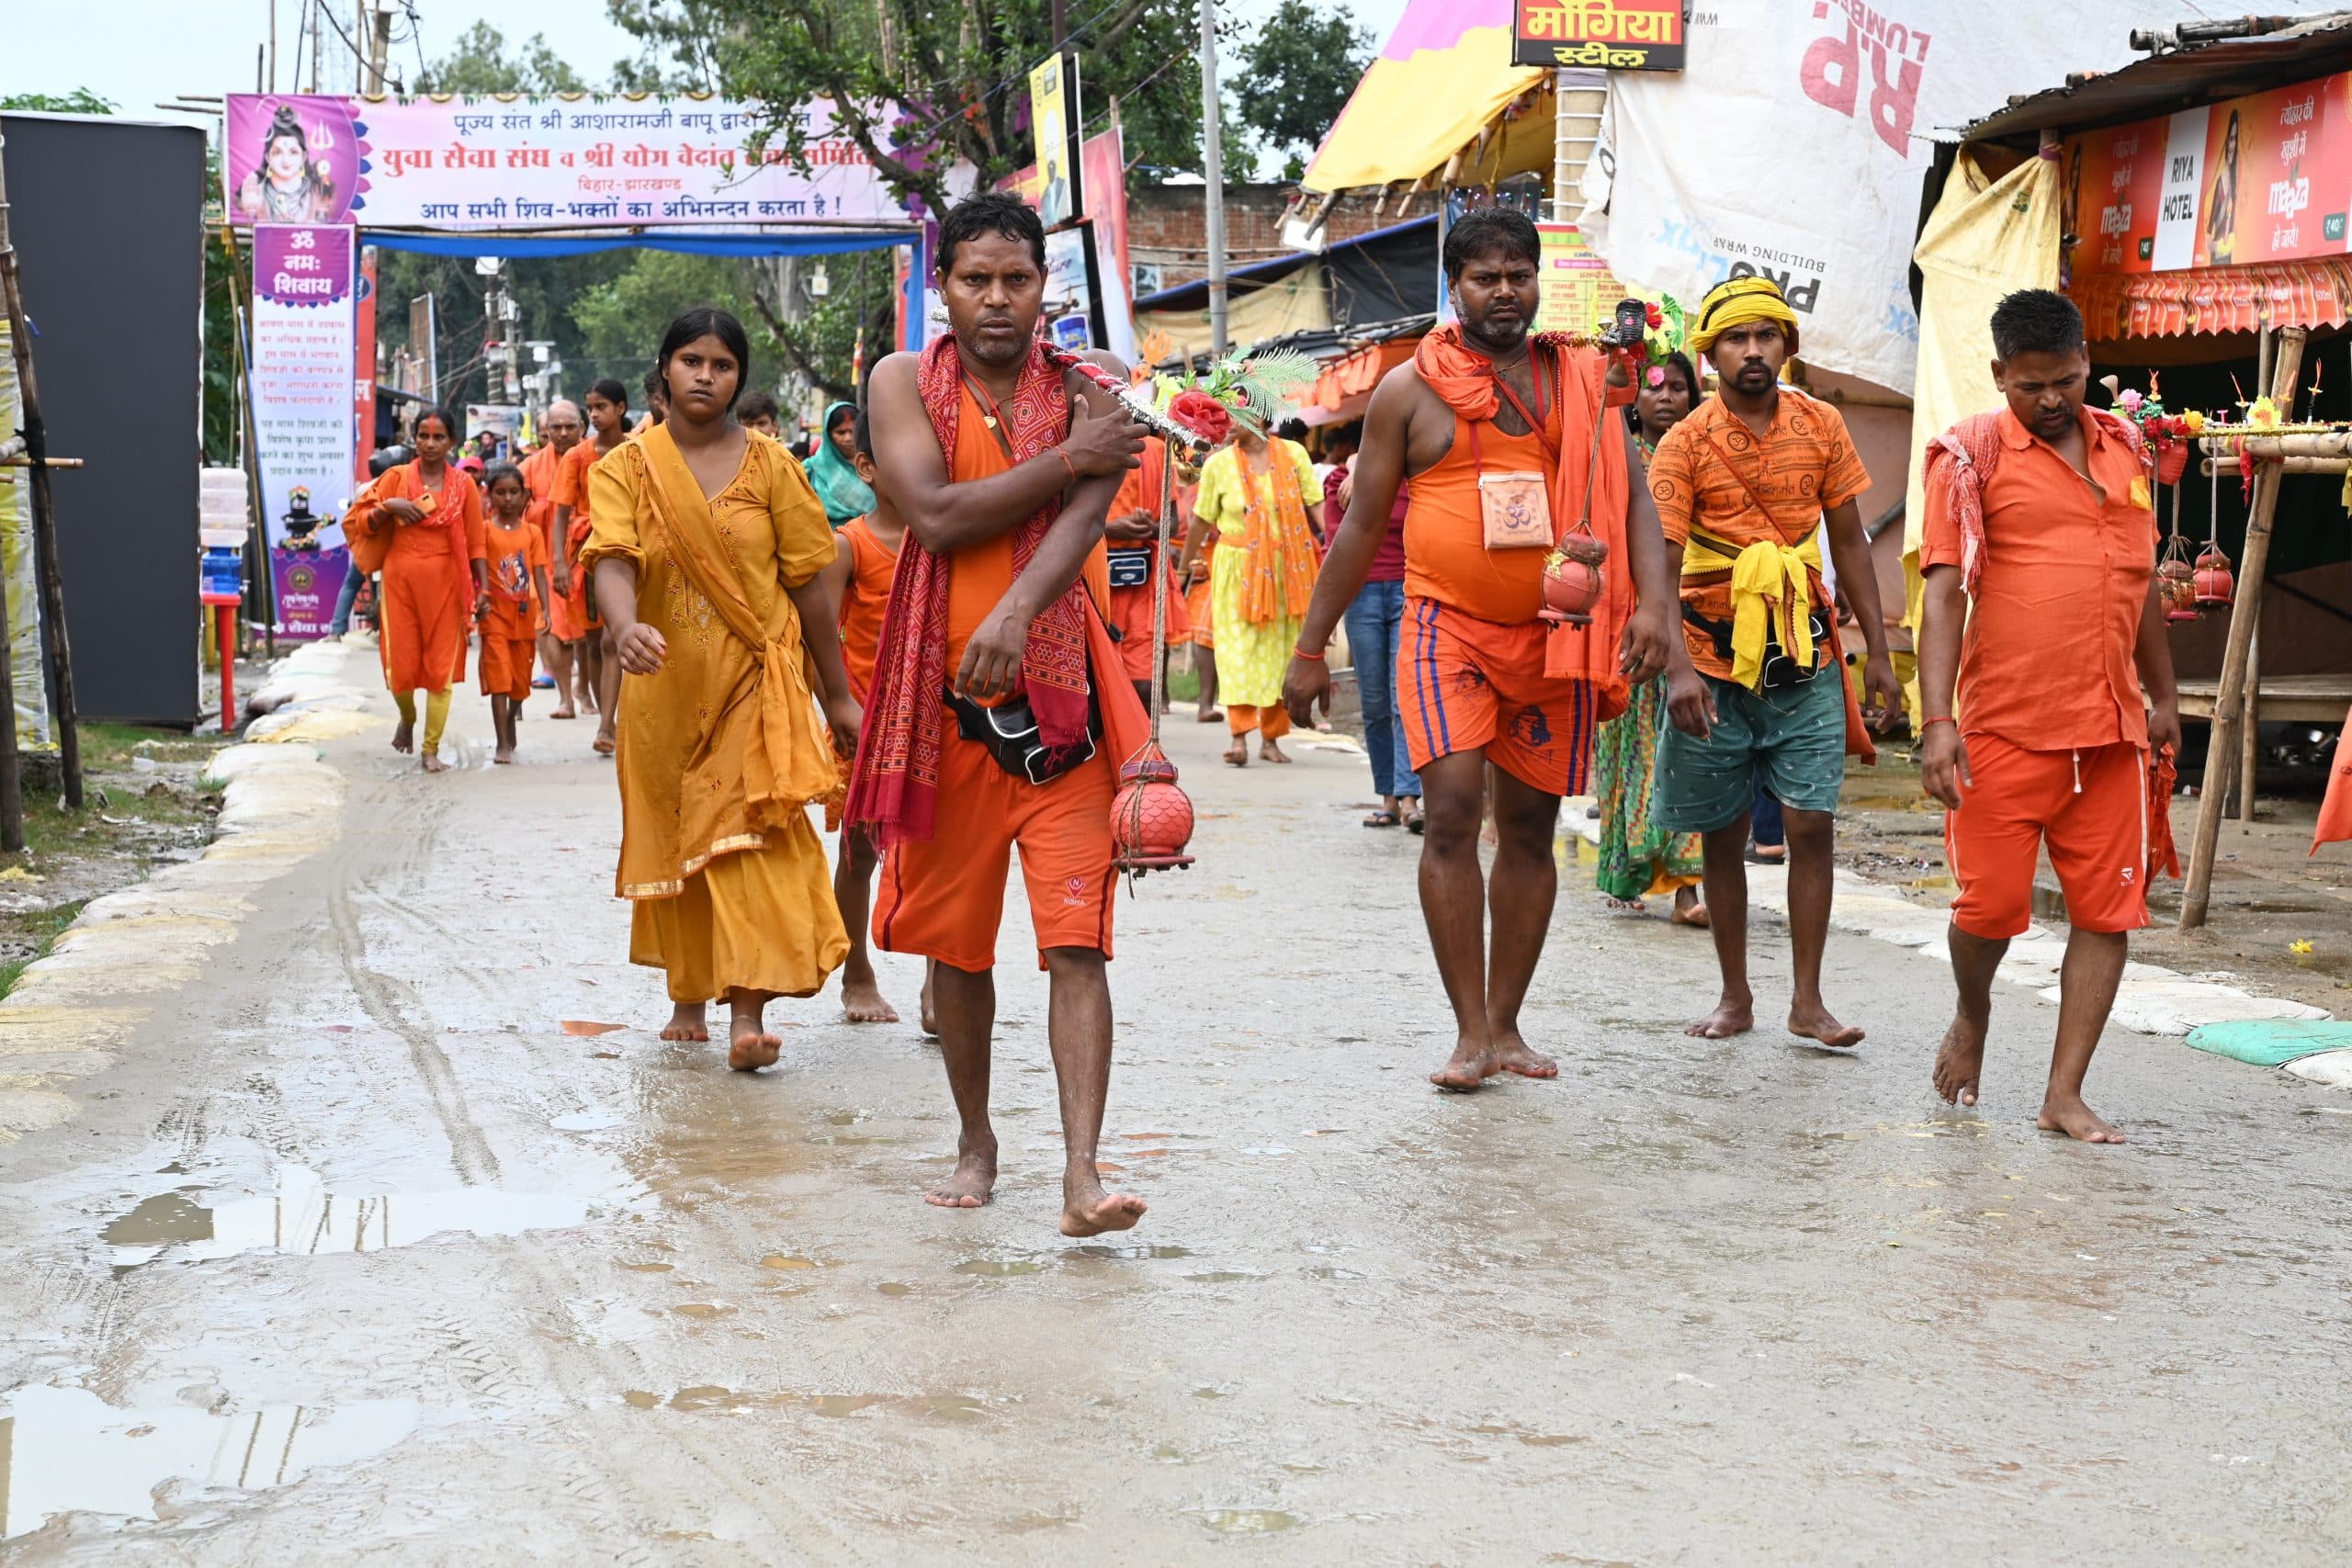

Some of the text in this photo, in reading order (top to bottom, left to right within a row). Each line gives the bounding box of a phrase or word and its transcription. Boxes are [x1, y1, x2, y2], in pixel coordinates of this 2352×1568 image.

[1553, 41, 1649, 66] स्टील
[454, 114, 493, 136] पूज्य
[502, 108, 532, 130] संत
[540, 108, 561, 130] श्री
[570, 107, 673, 130] आशारामजी
[680, 113, 718, 135] बापू
[2303, 96, 2314, 120] की
[382, 149, 433, 177] युवा
[441, 141, 497, 169] सेवा
[505, 140, 550, 168] संघ
[583, 142, 614, 168] श्री
[623, 142, 669, 167] योग
[676, 141, 736, 167] वेदांत
[2171, 154, 2194, 184] RIYA
[420, 203, 459, 220] आप
[468, 197, 508, 220] सभी
[627, 201, 652, 218] का
[662, 194, 750, 219] अभिनन्दन
[757, 200, 806, 218] करता
[814, 193, 826, 217] है
[2163, 194, 2193, 222] HOTEL
[290, 231, 315, 249] ॐ
[283, 254, 321, 271] नमः
[1713, 236, 1826, 273] BUILDING WRAP
[273, 272, 332, 294] शिवाय
